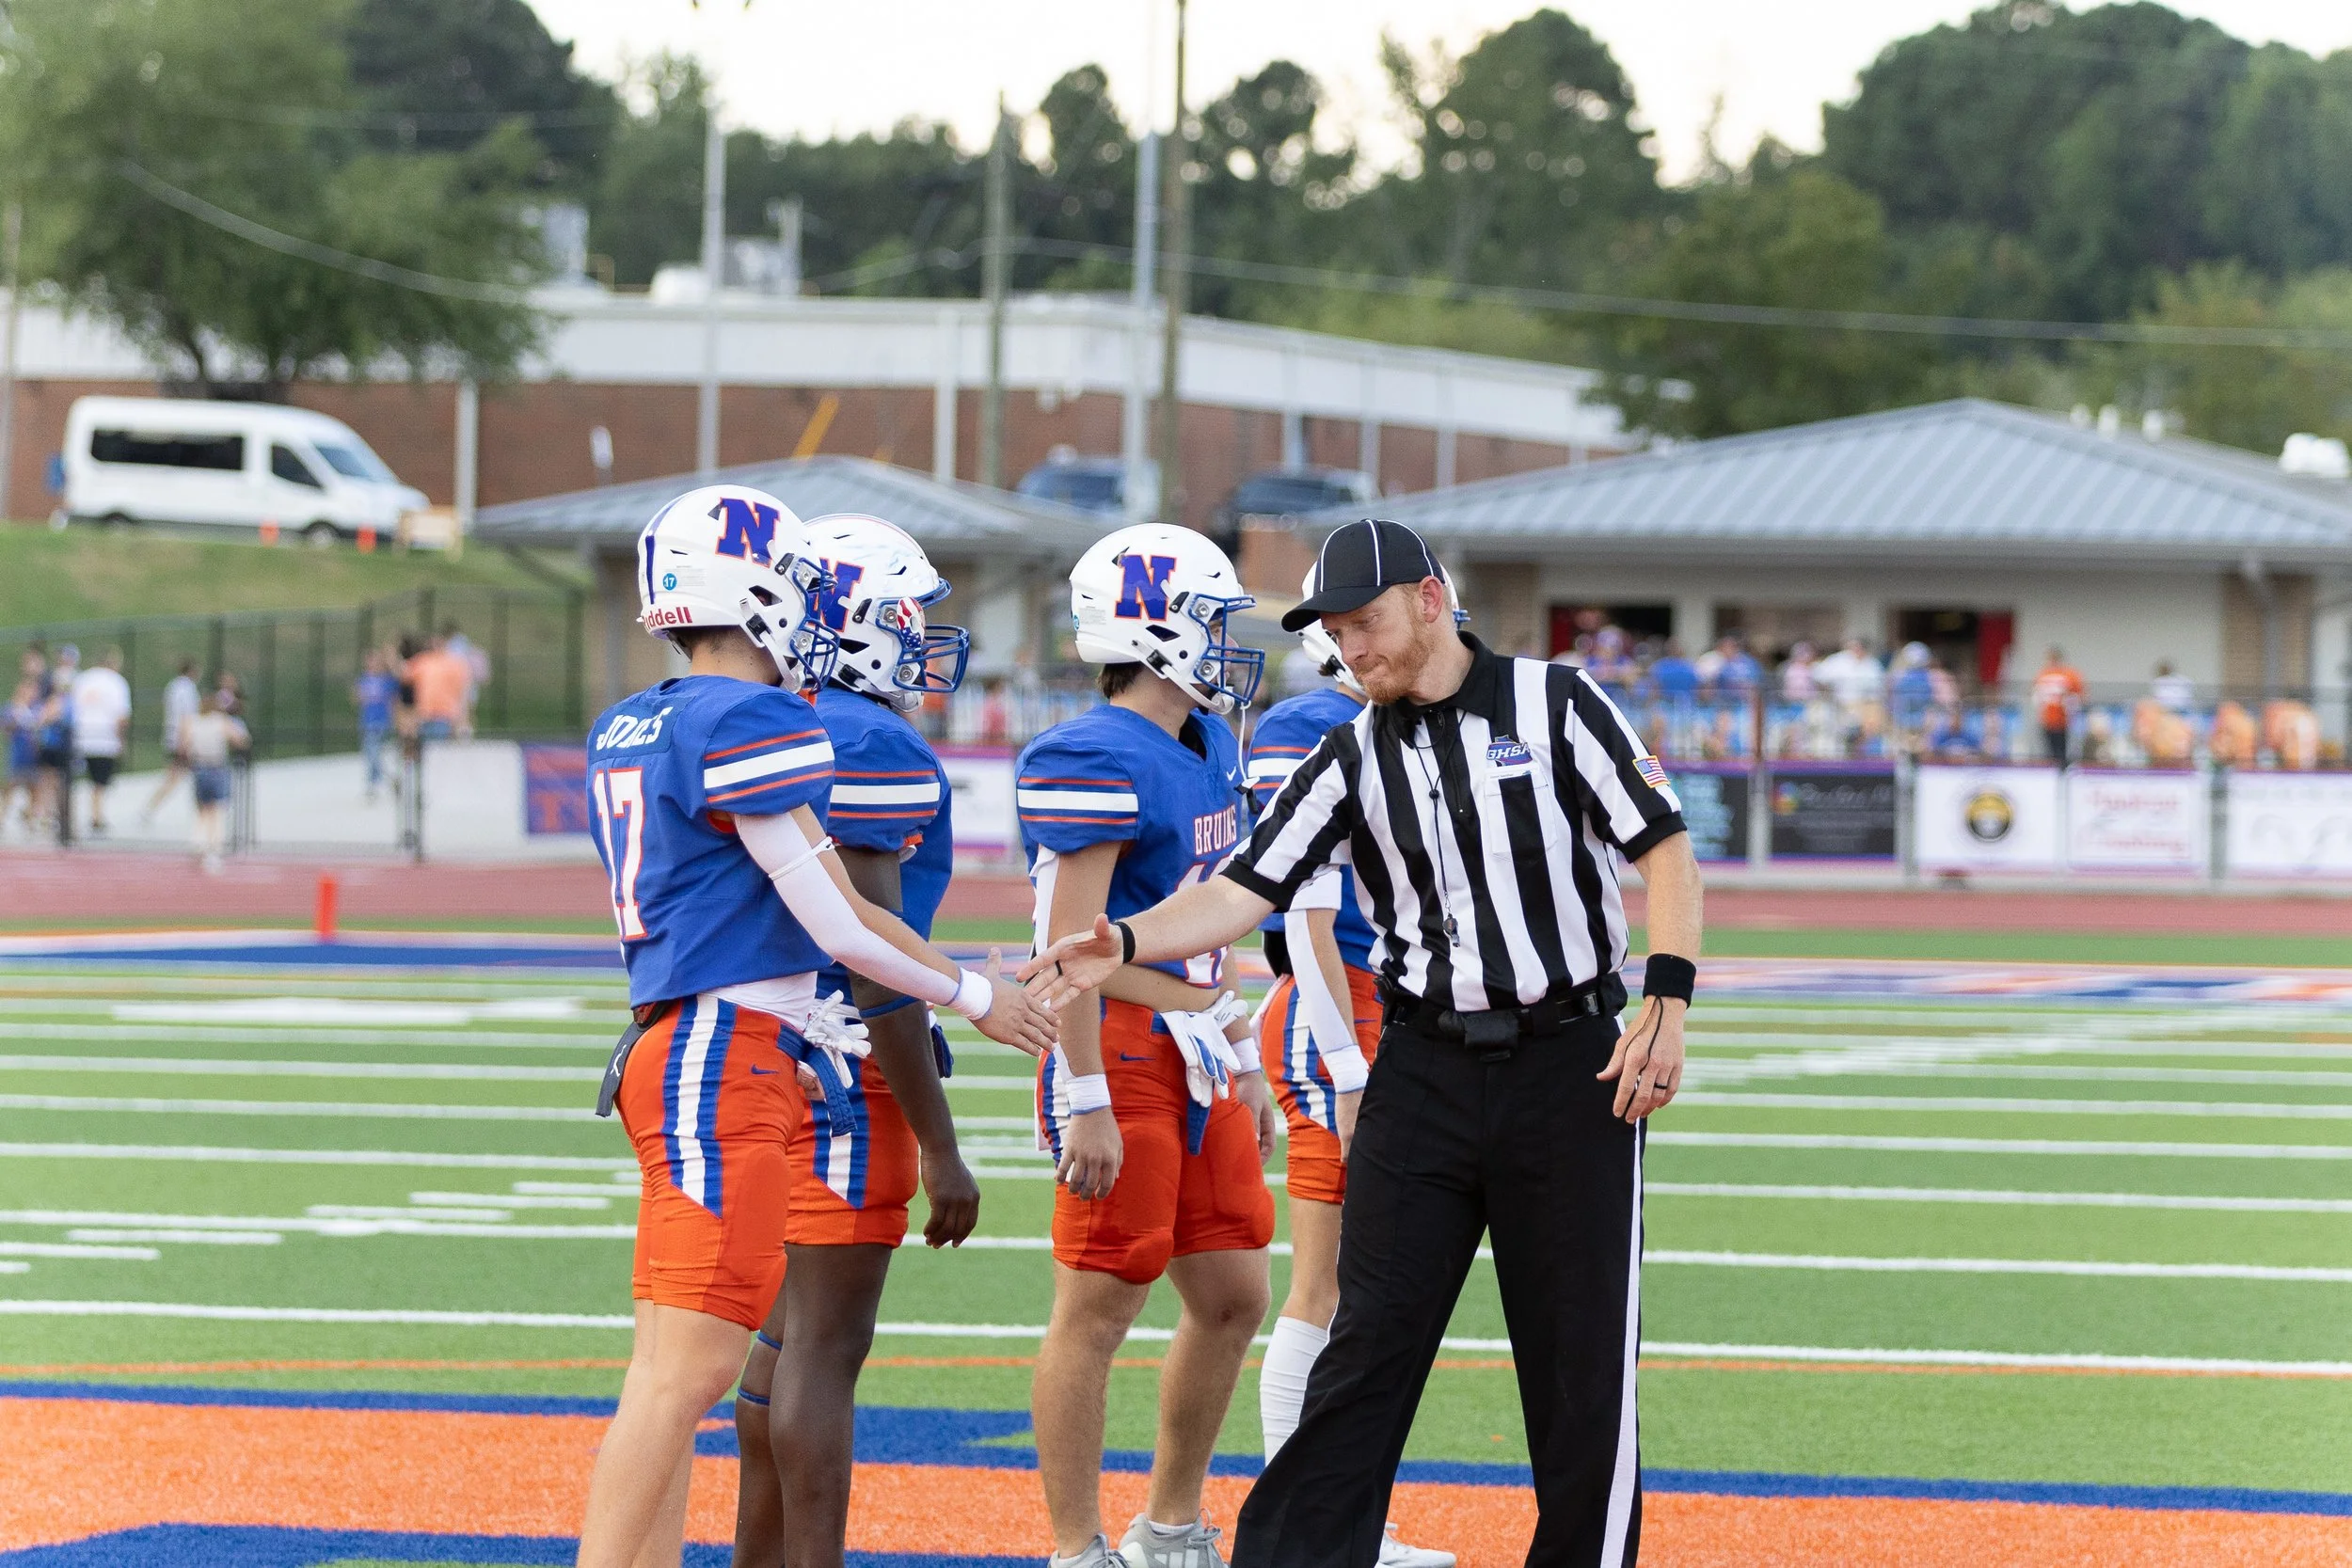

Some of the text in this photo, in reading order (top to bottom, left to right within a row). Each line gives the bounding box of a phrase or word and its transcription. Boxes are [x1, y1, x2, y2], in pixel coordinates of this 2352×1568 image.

[715, 497, 780, 569] N
[1114, 553, 1177, 622] N
[1486, 741, 1532, 760] GHSA
[594, 766, 649, 942] 17
[1193, 802, 1237, 857] BRUINS
